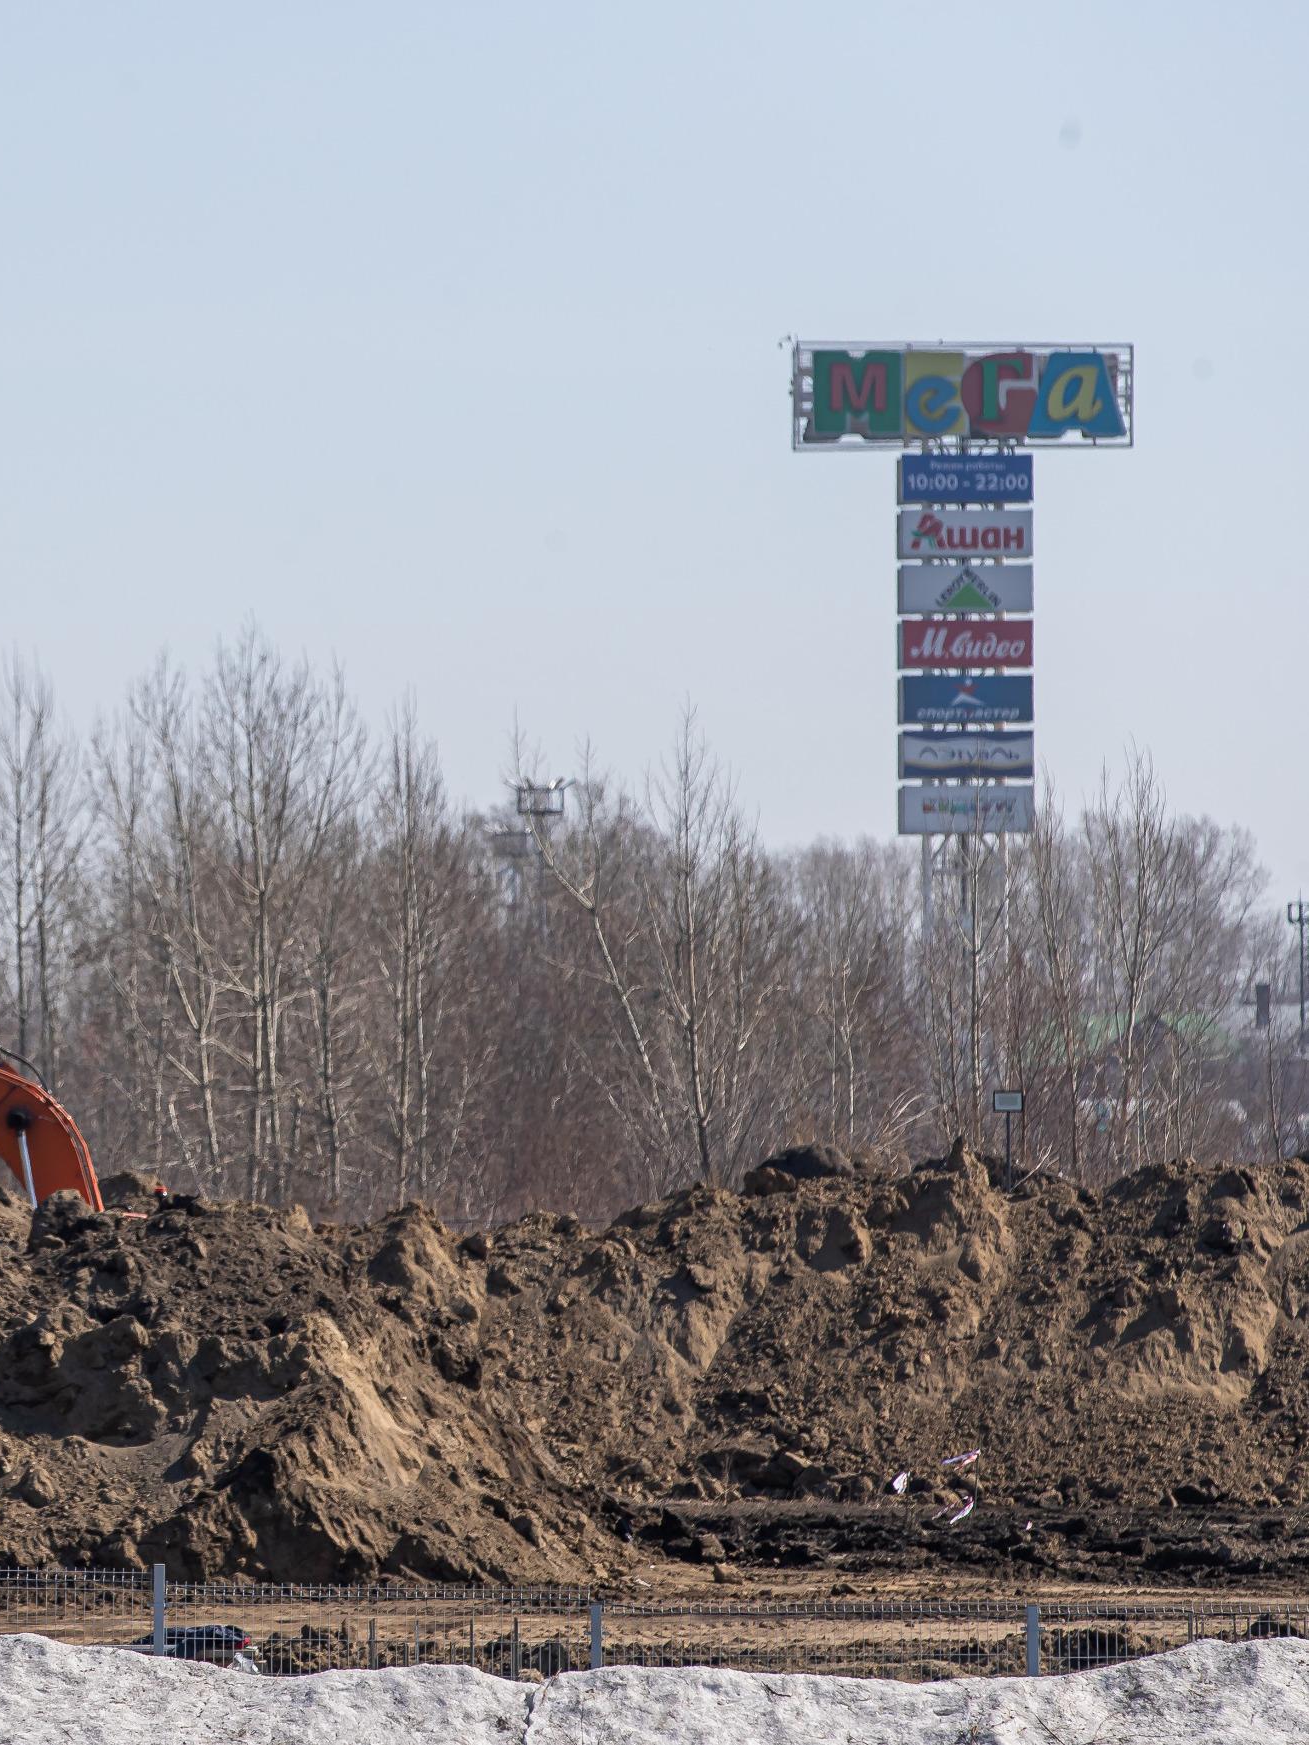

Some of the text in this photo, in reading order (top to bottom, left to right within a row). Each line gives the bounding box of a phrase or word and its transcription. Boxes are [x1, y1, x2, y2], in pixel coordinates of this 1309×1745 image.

[908, 473, 959, 491] 10:00
[975, 473, 1029, 491] 22:00
[911, 513, 1024, 551] Ашан
[910, 626, 1027, 659] М.видео
